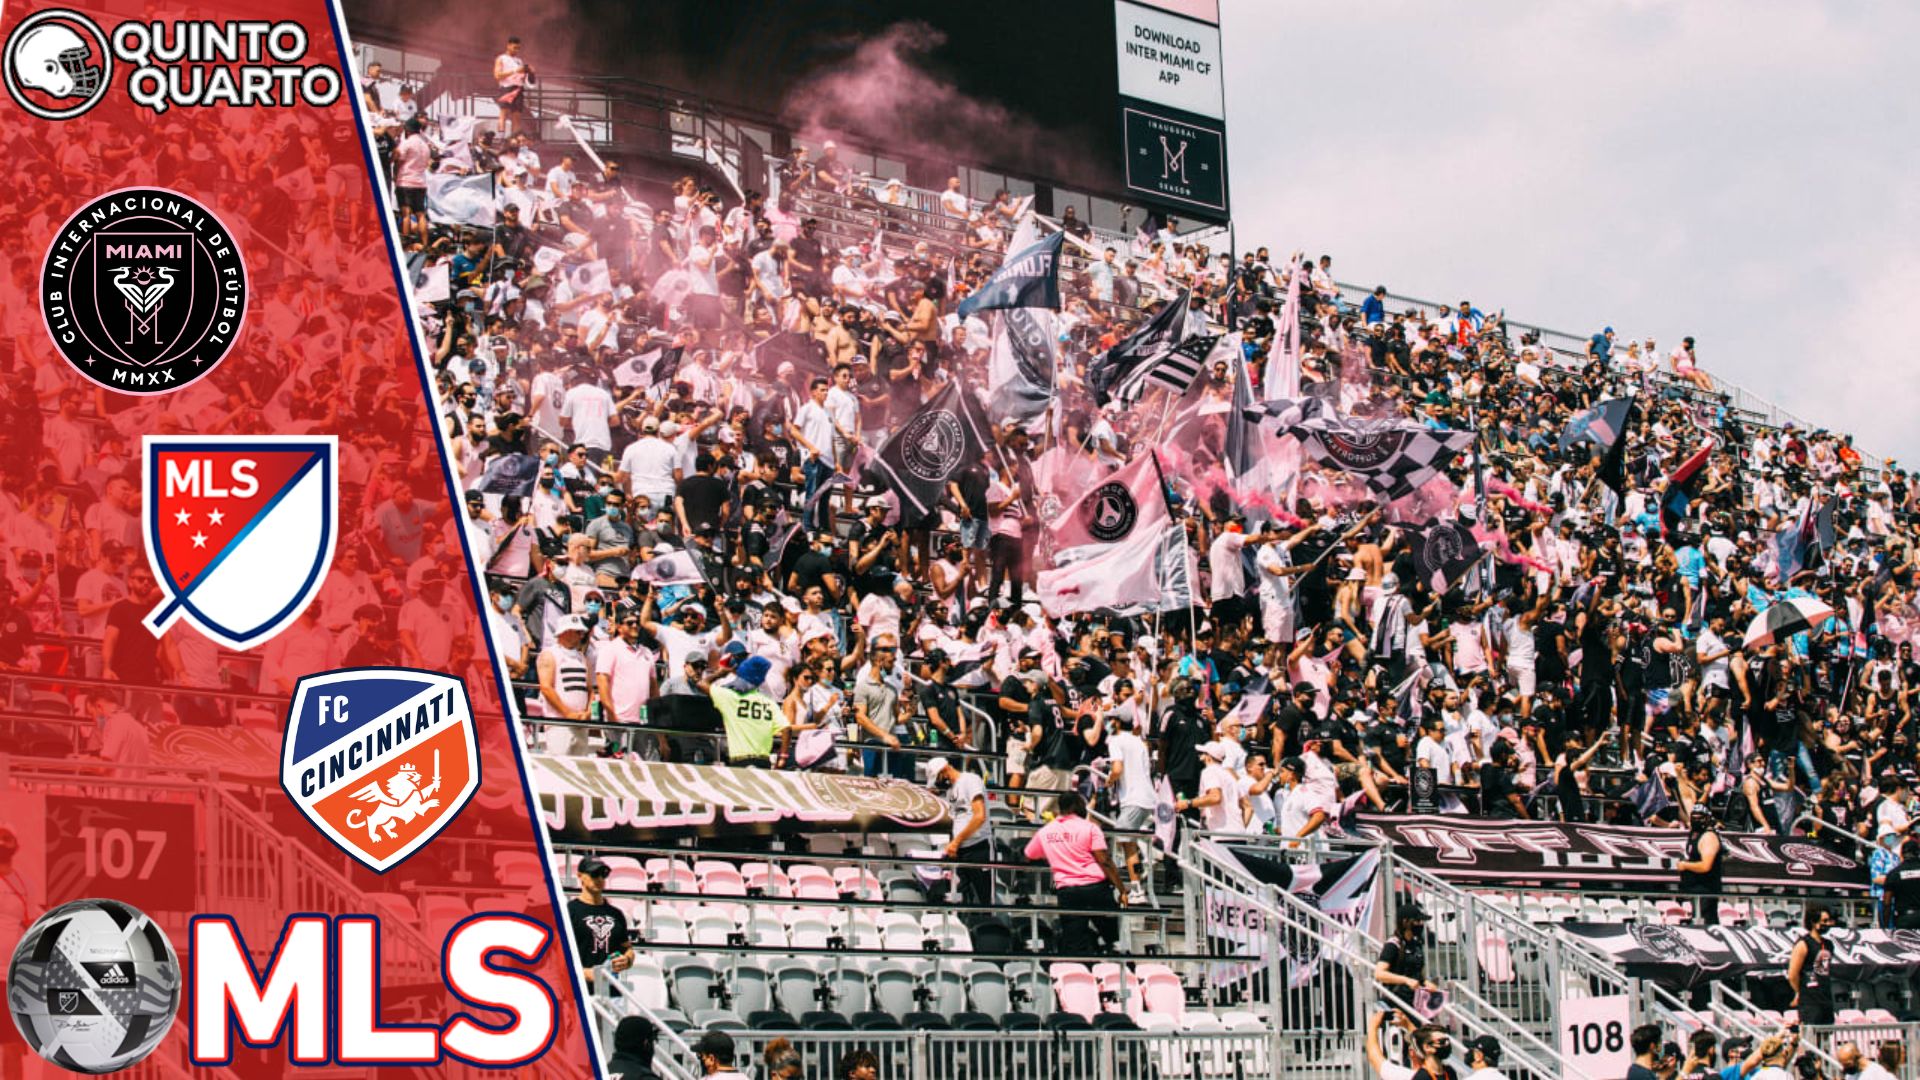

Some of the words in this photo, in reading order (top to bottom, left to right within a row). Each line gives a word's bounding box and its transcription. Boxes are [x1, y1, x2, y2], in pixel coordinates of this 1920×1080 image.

[1134, 25, 1200, 54] DOWNLOAD
[1126, 42, 1158, 61] INTER
[1160, 51, 1195, 72] MIAMI
[1196, 61, 1211, 76] CF
[1159, 70, 1180, 85] APP
[737, 699, 773, 721] 265
[77, 826, 167, 880] 107
[1568, 1021, 1624, 1056] 108
